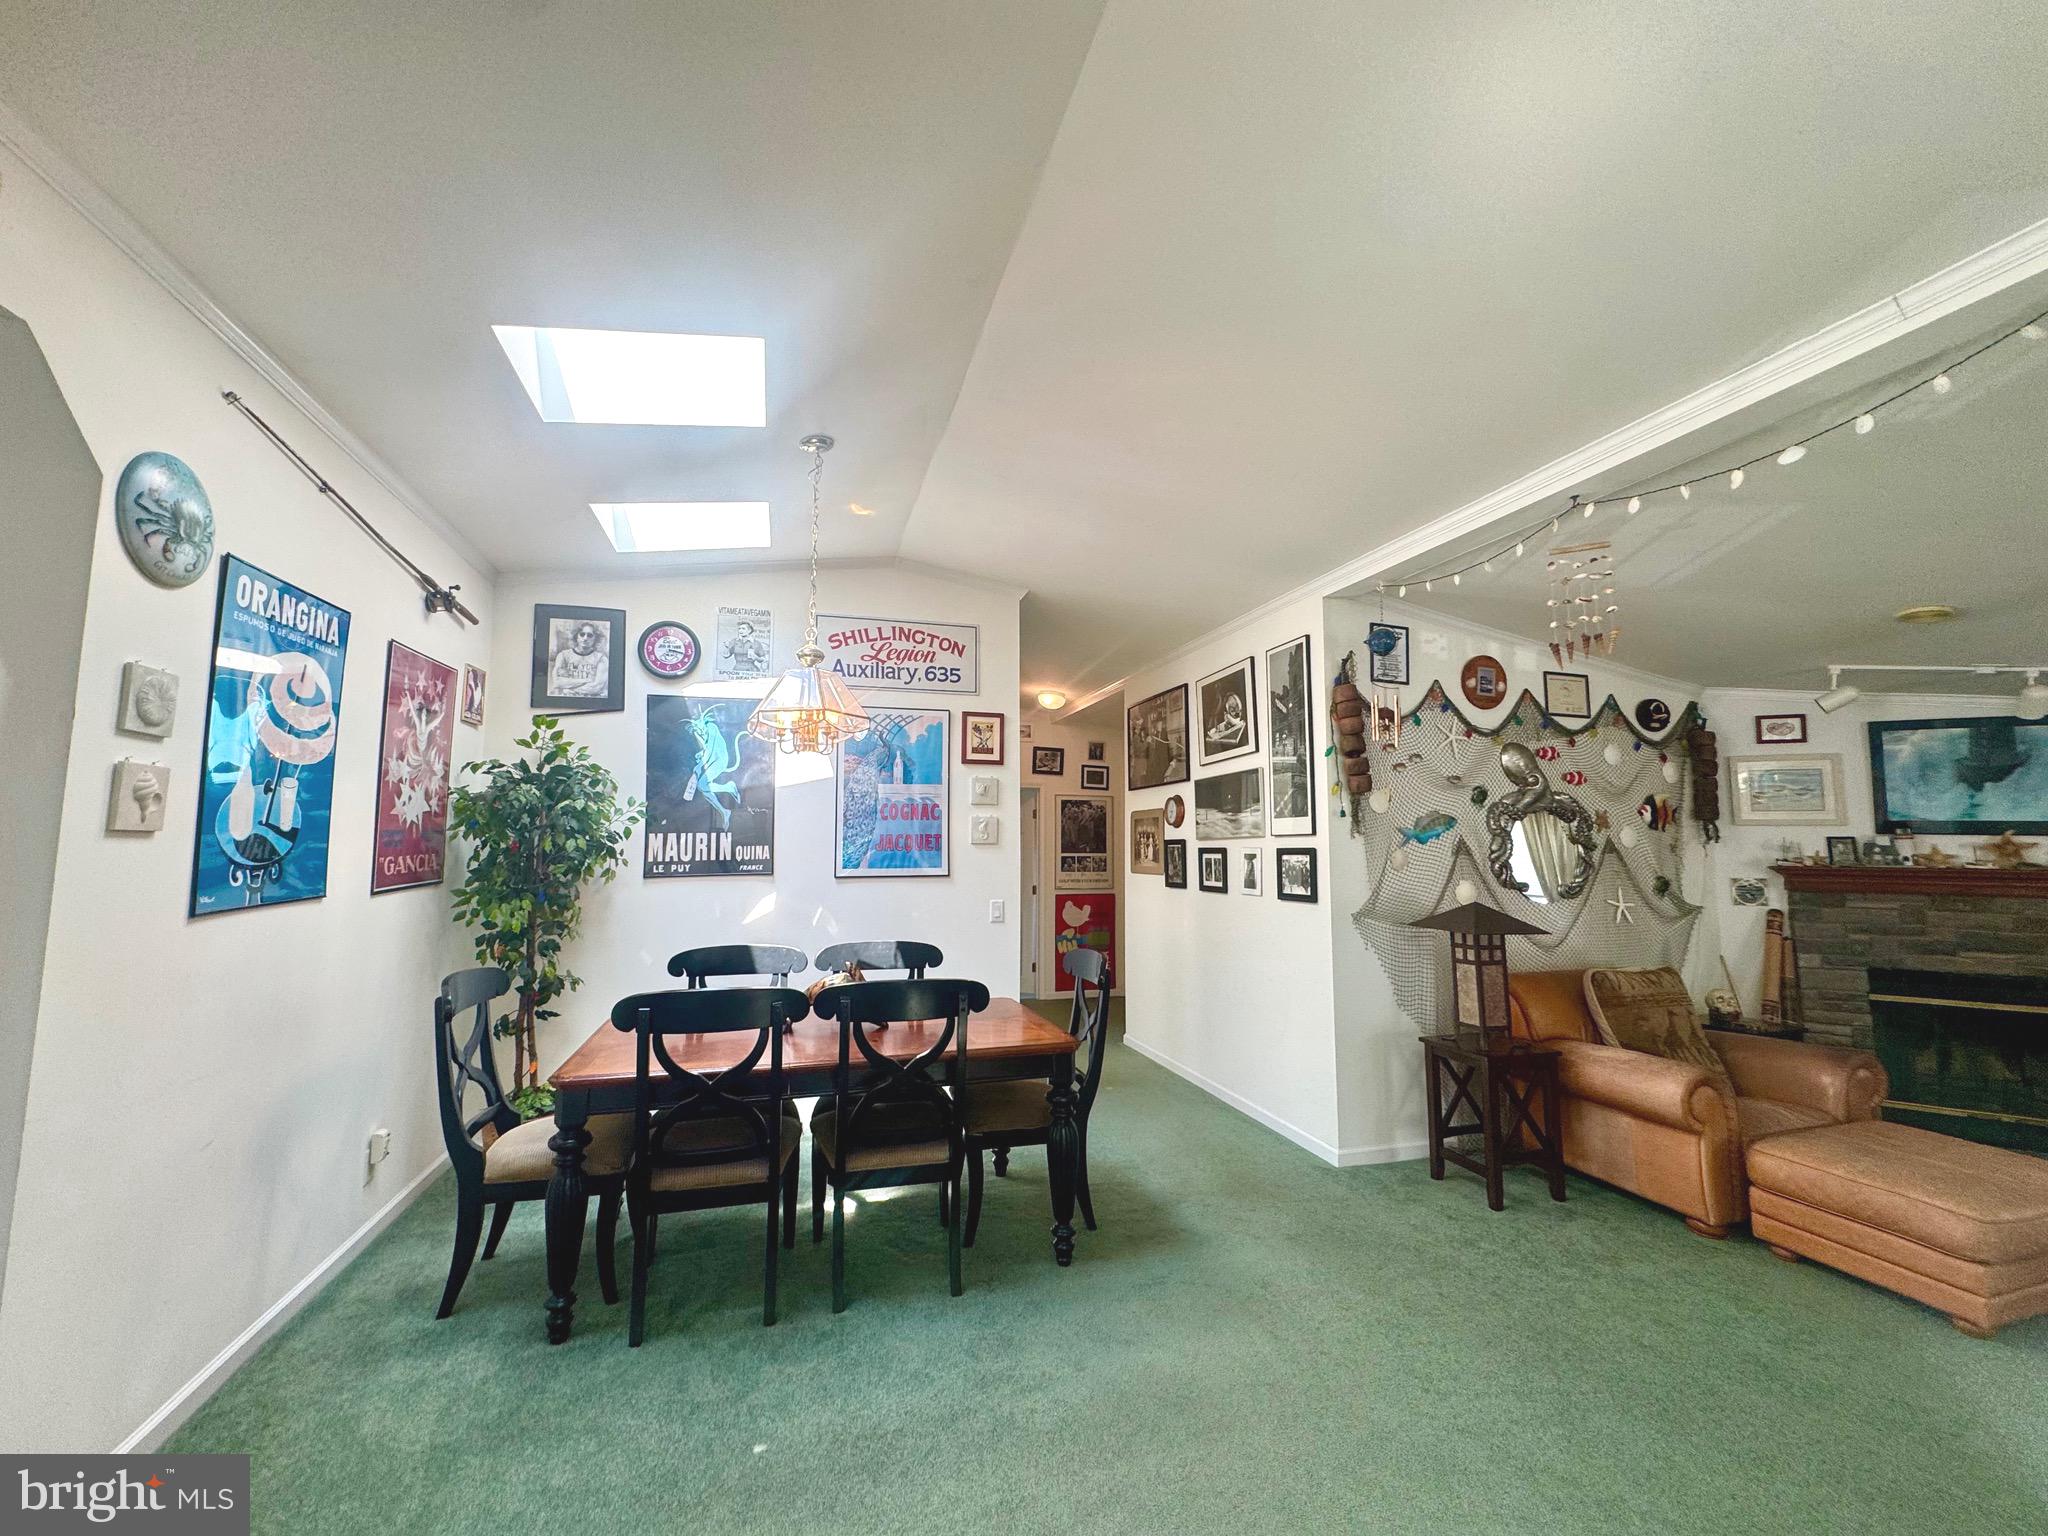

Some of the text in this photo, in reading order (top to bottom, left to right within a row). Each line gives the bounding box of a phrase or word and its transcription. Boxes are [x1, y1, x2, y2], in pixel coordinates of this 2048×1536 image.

[236, 574, 339, 646] ORANGINA
[718, 607, 771, 617] VITAMEATAVEGAMIN
[233, 610, 338, 657] ESPUMOSO DE JUGO DE NARANJA
[828, 626, 967, 658] SHILLINGTON
[861, 642, 937, 665] Legion
[924, 666, 962, 683] 635
[880, 803, 940, 821] COGNAC
[647, 832, 770, 862] MAURIN QUINA
[875, 833, 942, 853] JACQUET
[653, 865, 665, 873] LE
[670, 864, 691, 873] PUY
